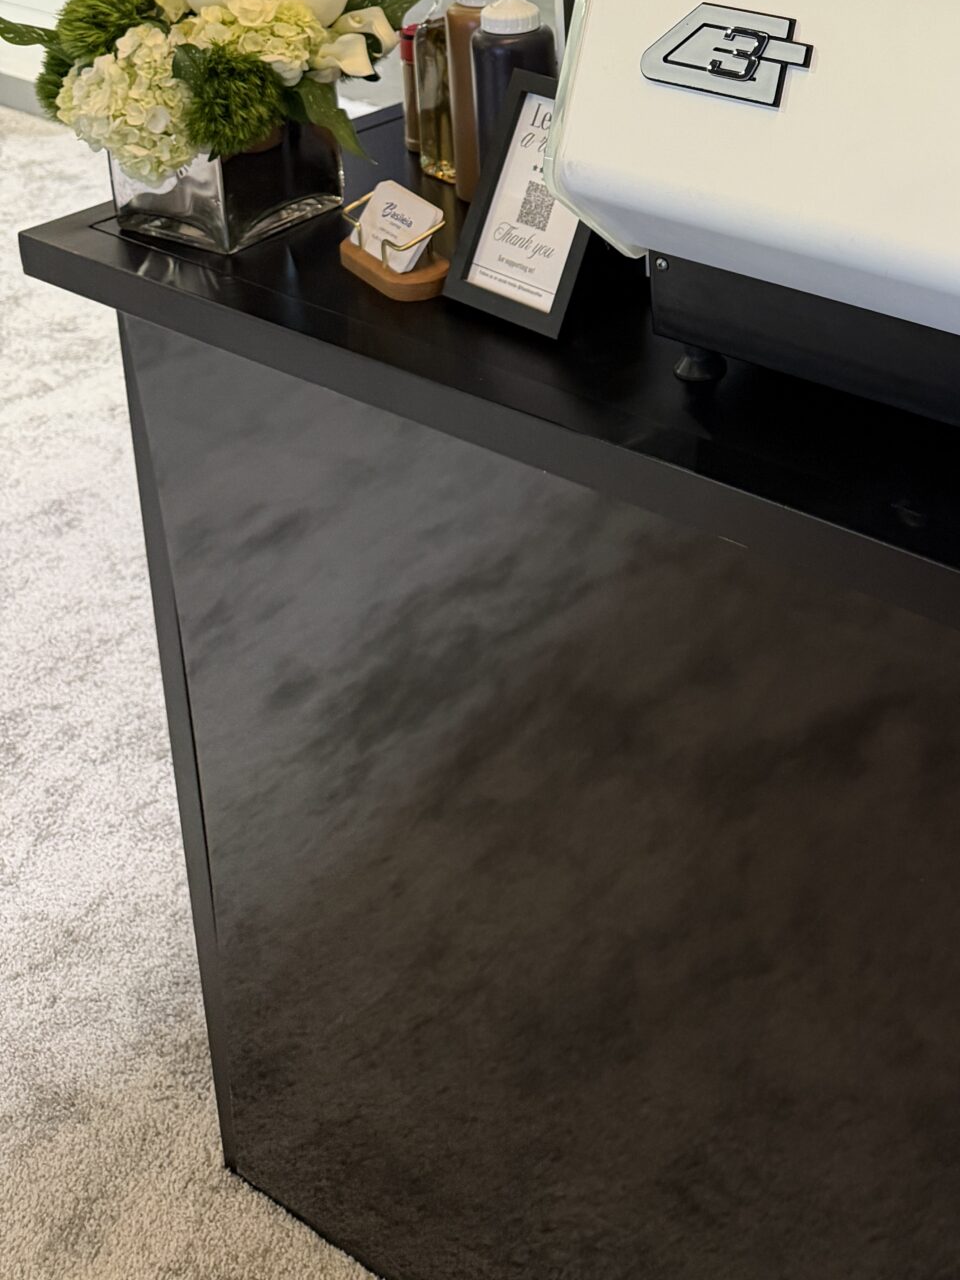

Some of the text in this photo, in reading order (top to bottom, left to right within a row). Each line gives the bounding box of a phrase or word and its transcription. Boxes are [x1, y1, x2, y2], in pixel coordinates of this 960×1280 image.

[520, 132, 535, 148] a
[493, 221, 555, 259] Thank you
